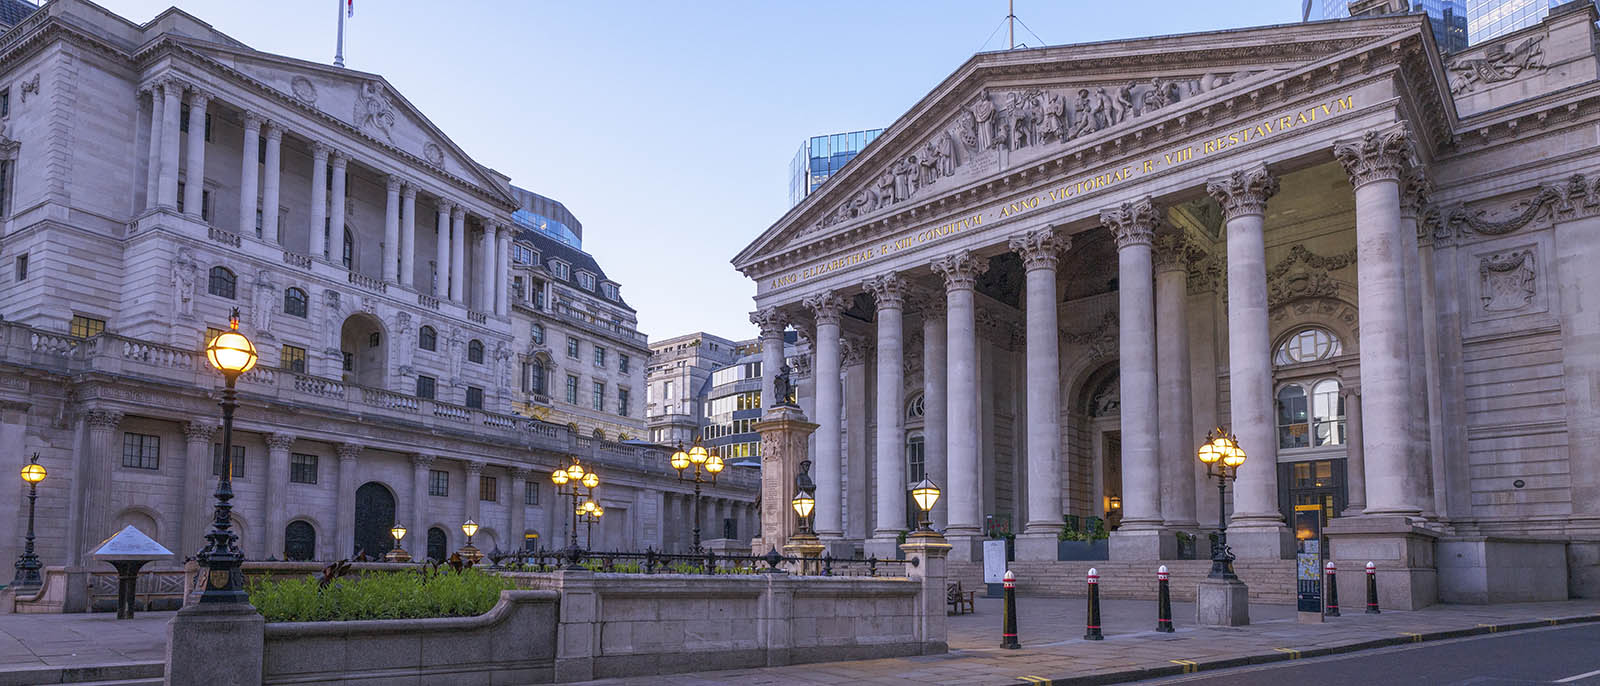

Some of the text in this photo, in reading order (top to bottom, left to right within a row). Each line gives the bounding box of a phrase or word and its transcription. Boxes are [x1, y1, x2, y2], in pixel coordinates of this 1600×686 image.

[770, 95, 1354, 289] ANNO ELIZABETHAE R XIII CONDITVM ANNO VICTORIAE R VIII RESTAVRATVM
